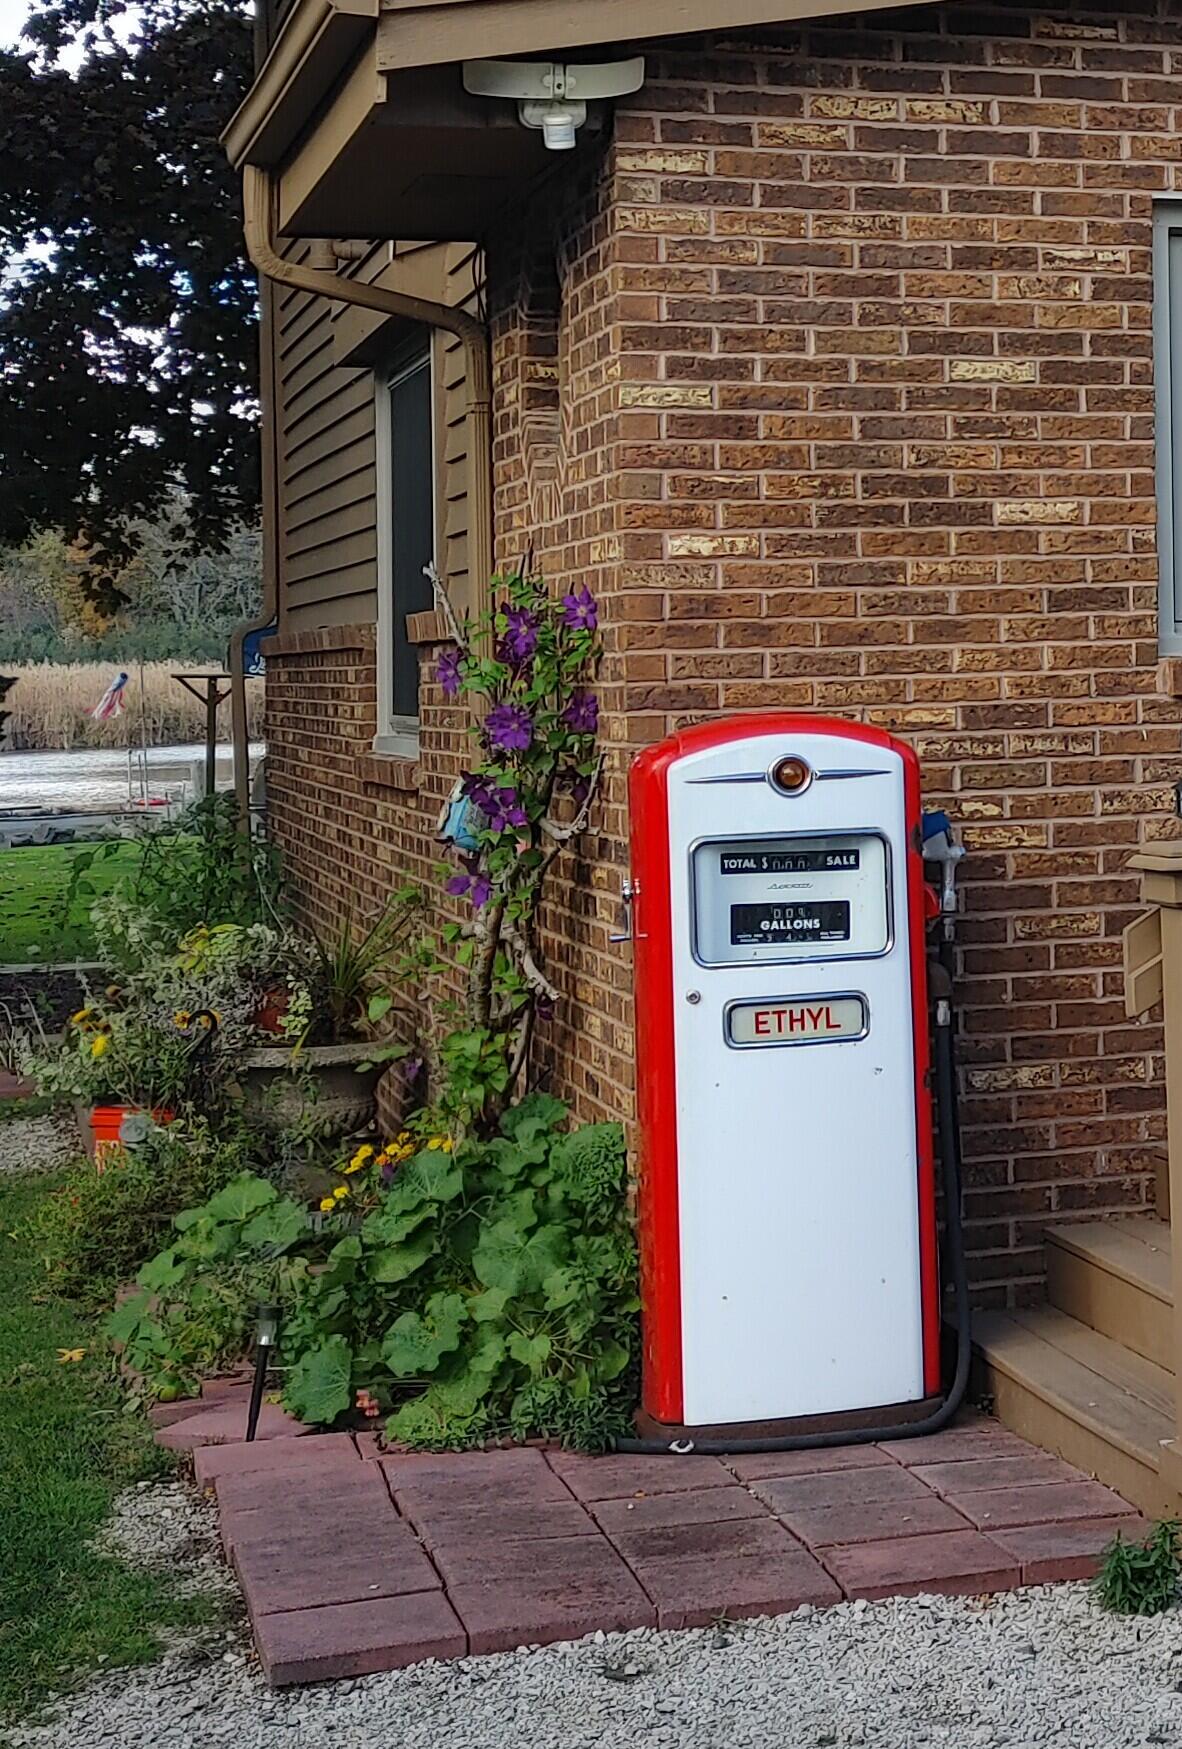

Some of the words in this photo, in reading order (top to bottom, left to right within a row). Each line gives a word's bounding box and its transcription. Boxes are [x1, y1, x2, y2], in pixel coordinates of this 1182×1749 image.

[723, 858, 757, 869] TOTAL
[825, 854, 856, 866] SALE
[760, 918, 821, 931] GALLONS
[754, 1006, 842, 1035] ETHYL
